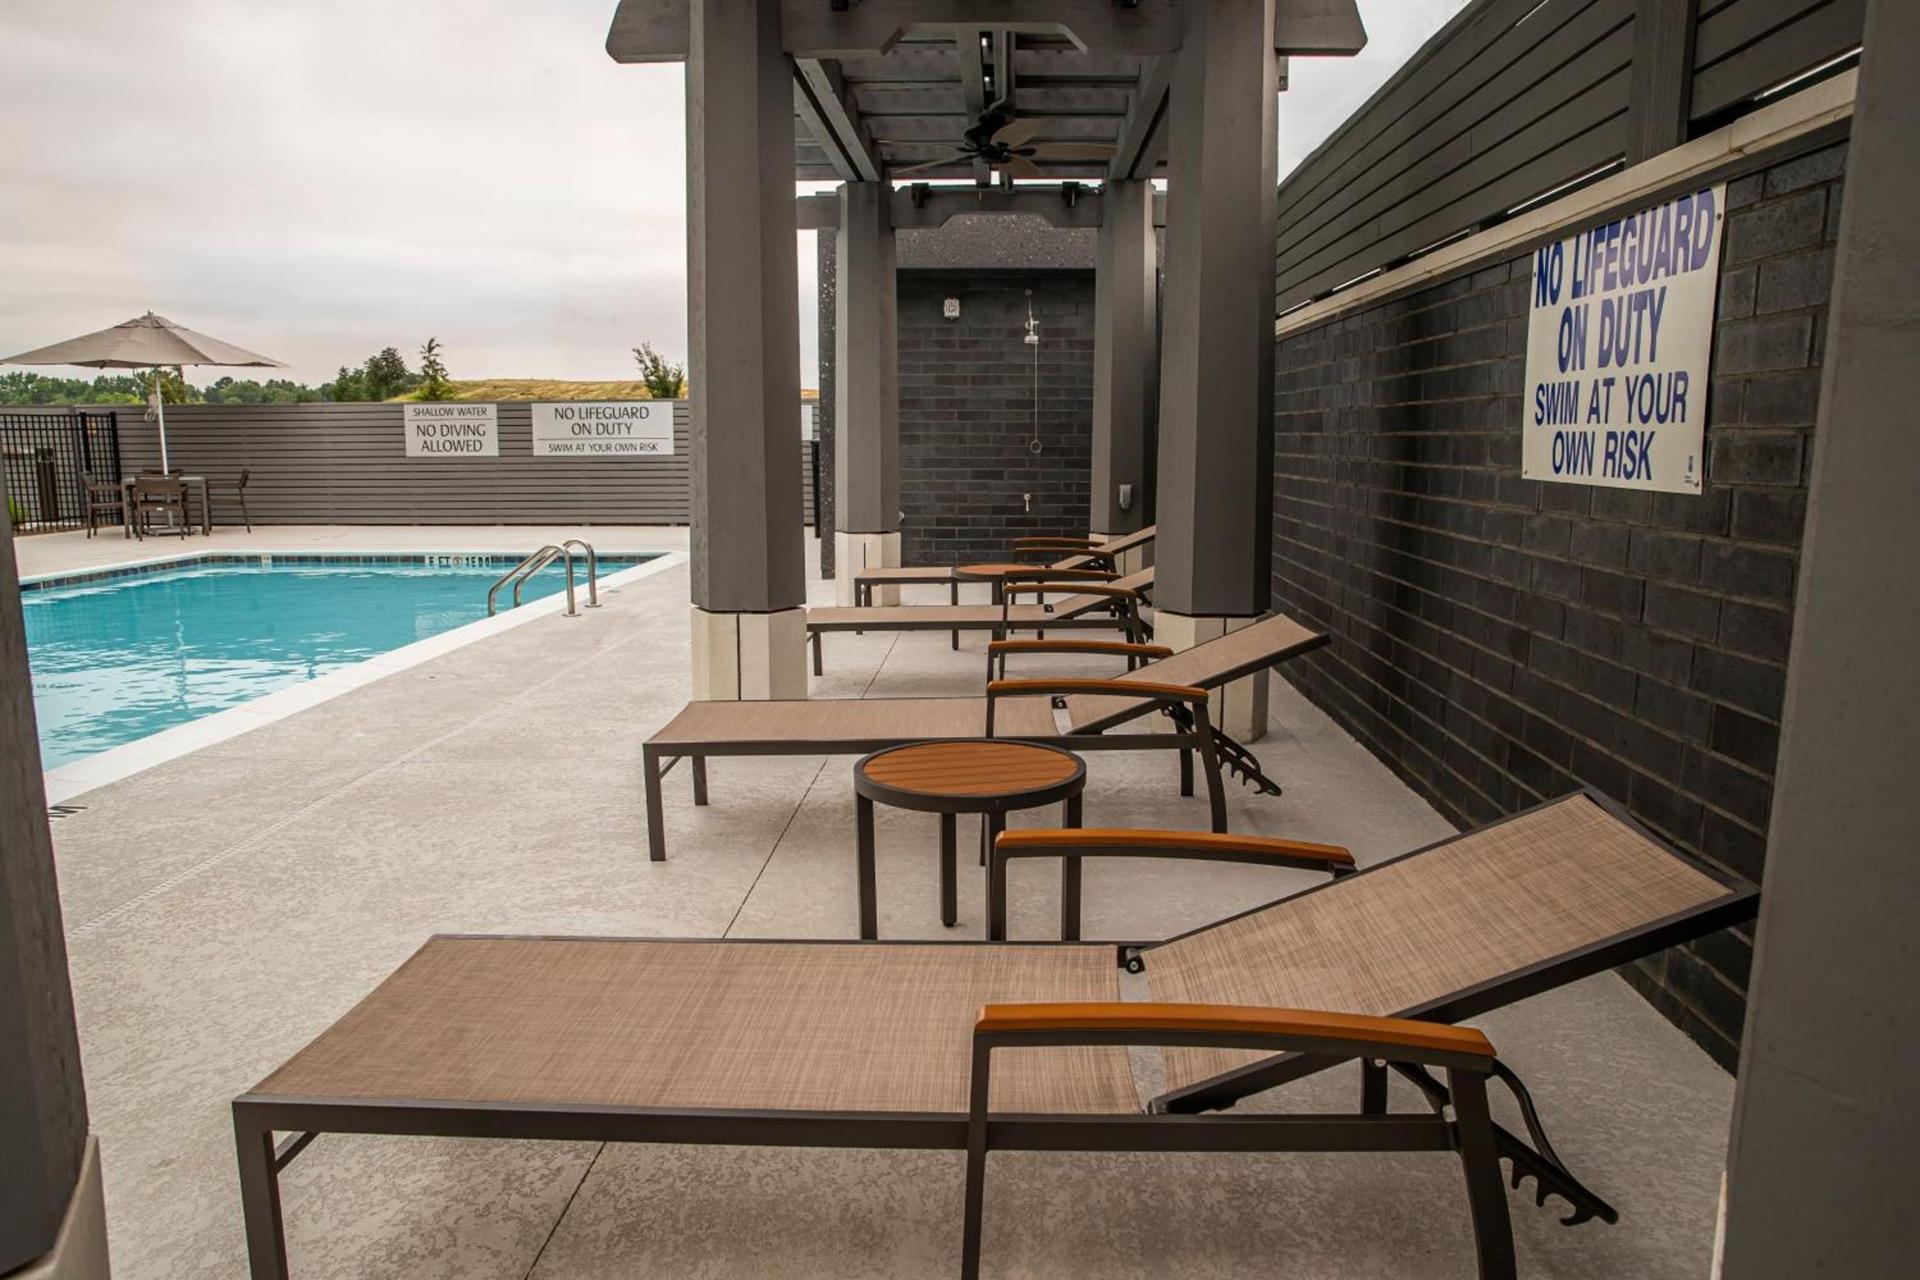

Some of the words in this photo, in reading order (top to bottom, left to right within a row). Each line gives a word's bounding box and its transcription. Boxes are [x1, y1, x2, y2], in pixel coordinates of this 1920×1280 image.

[1535, 241, 1563, 308] NO
[1572, 187, 1715, 299] LIFEGUARD
[1558, 304, 1588, 373] ON
[1598, 286, 1667, 368] DUTY
[1535, 381, 1579, 426] SWIM
[1587, 377, 1615, 424] AT
[1625, 371, 1689, 424] YOUR
[413, 407, 456, 417] SHALLOW
[458, 407, 487, 417] WATER
[555, 408, 575, 420] NO
[579, 407, 649, 420] LIFEGUARD
[416, 425, 437, 437] NO
[441, 424, 486, 437] DIVING
[572, 424, 591, 435] ON
[595, 423, 633, 436] DUTY
[421, 439, 483, 453] ALLOWED
[548, 443, 573, 453] SWIM
[575, 443, 586, 453] AT
[588, 443, 612, 453] YOUR
[614, 443, 637, 453] OWN
[640, 443, 658, 452] RISK
[1552, 431, 1595, 476] OWN
[1603, 431, 1655, 480] RISK
